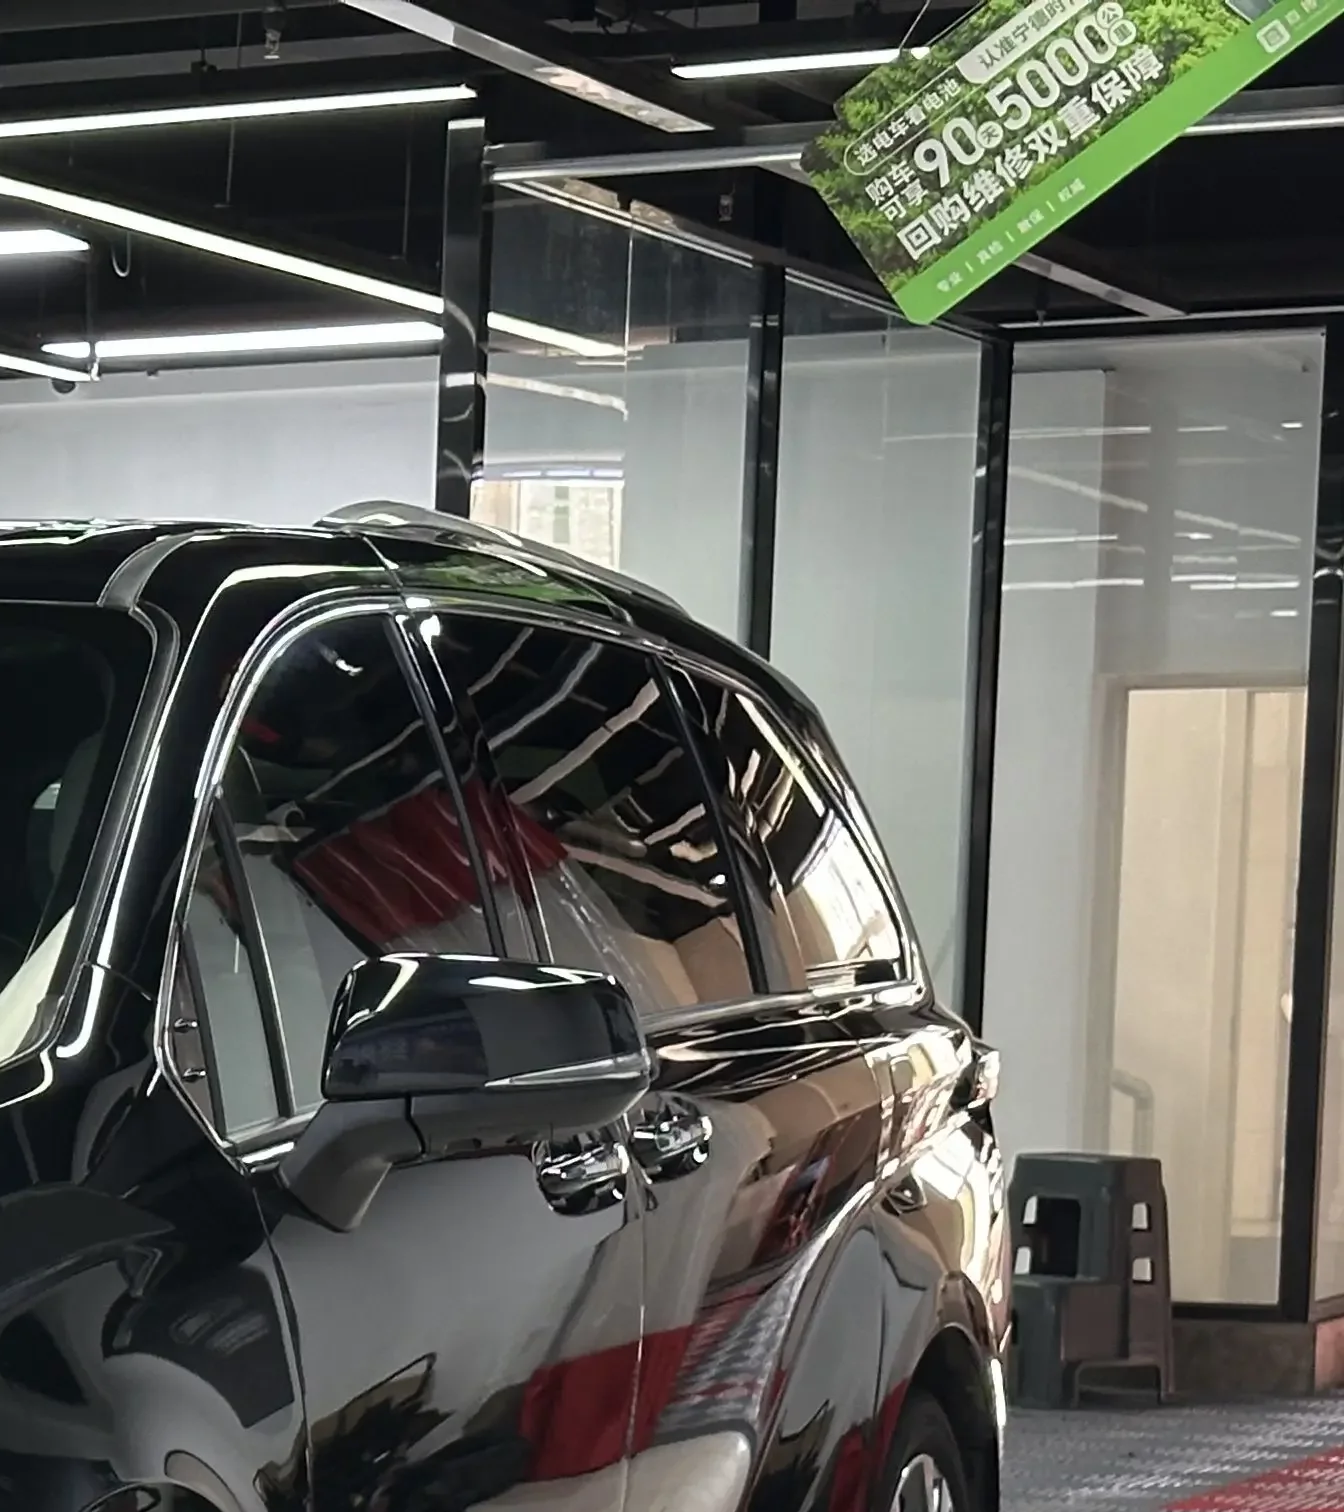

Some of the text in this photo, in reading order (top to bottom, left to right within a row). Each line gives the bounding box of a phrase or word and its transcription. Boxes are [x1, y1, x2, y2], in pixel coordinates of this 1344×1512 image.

[979, 0, 1074, 70] 认准宁德时
[854, 78, 962, 166] 选电车看电池
[897, 44, 1164, 260] 回购维修双重保障
